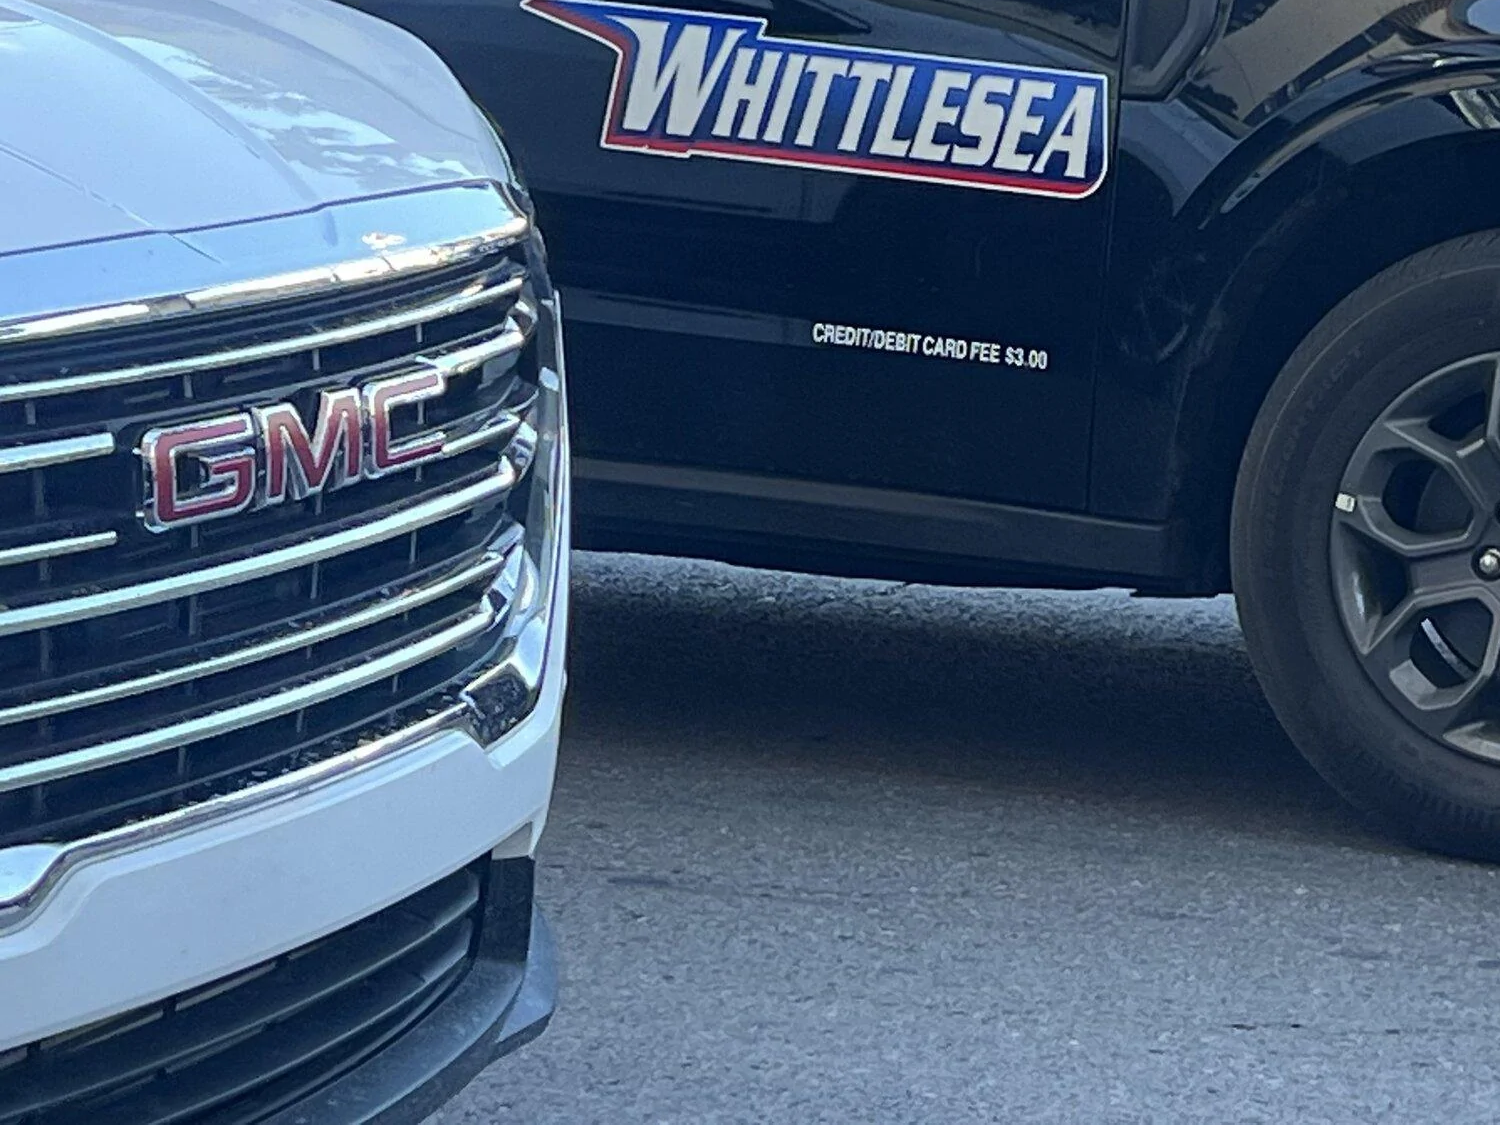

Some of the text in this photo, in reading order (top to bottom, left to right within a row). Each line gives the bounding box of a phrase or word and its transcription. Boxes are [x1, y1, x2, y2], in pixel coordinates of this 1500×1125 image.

[604, 13, 1099, 179] WHITTLESEA
[812, 323, 1048, 370] CREDIT/DEBIT CARD FEE $3.00
[140, 372, 447, 534] GMC
